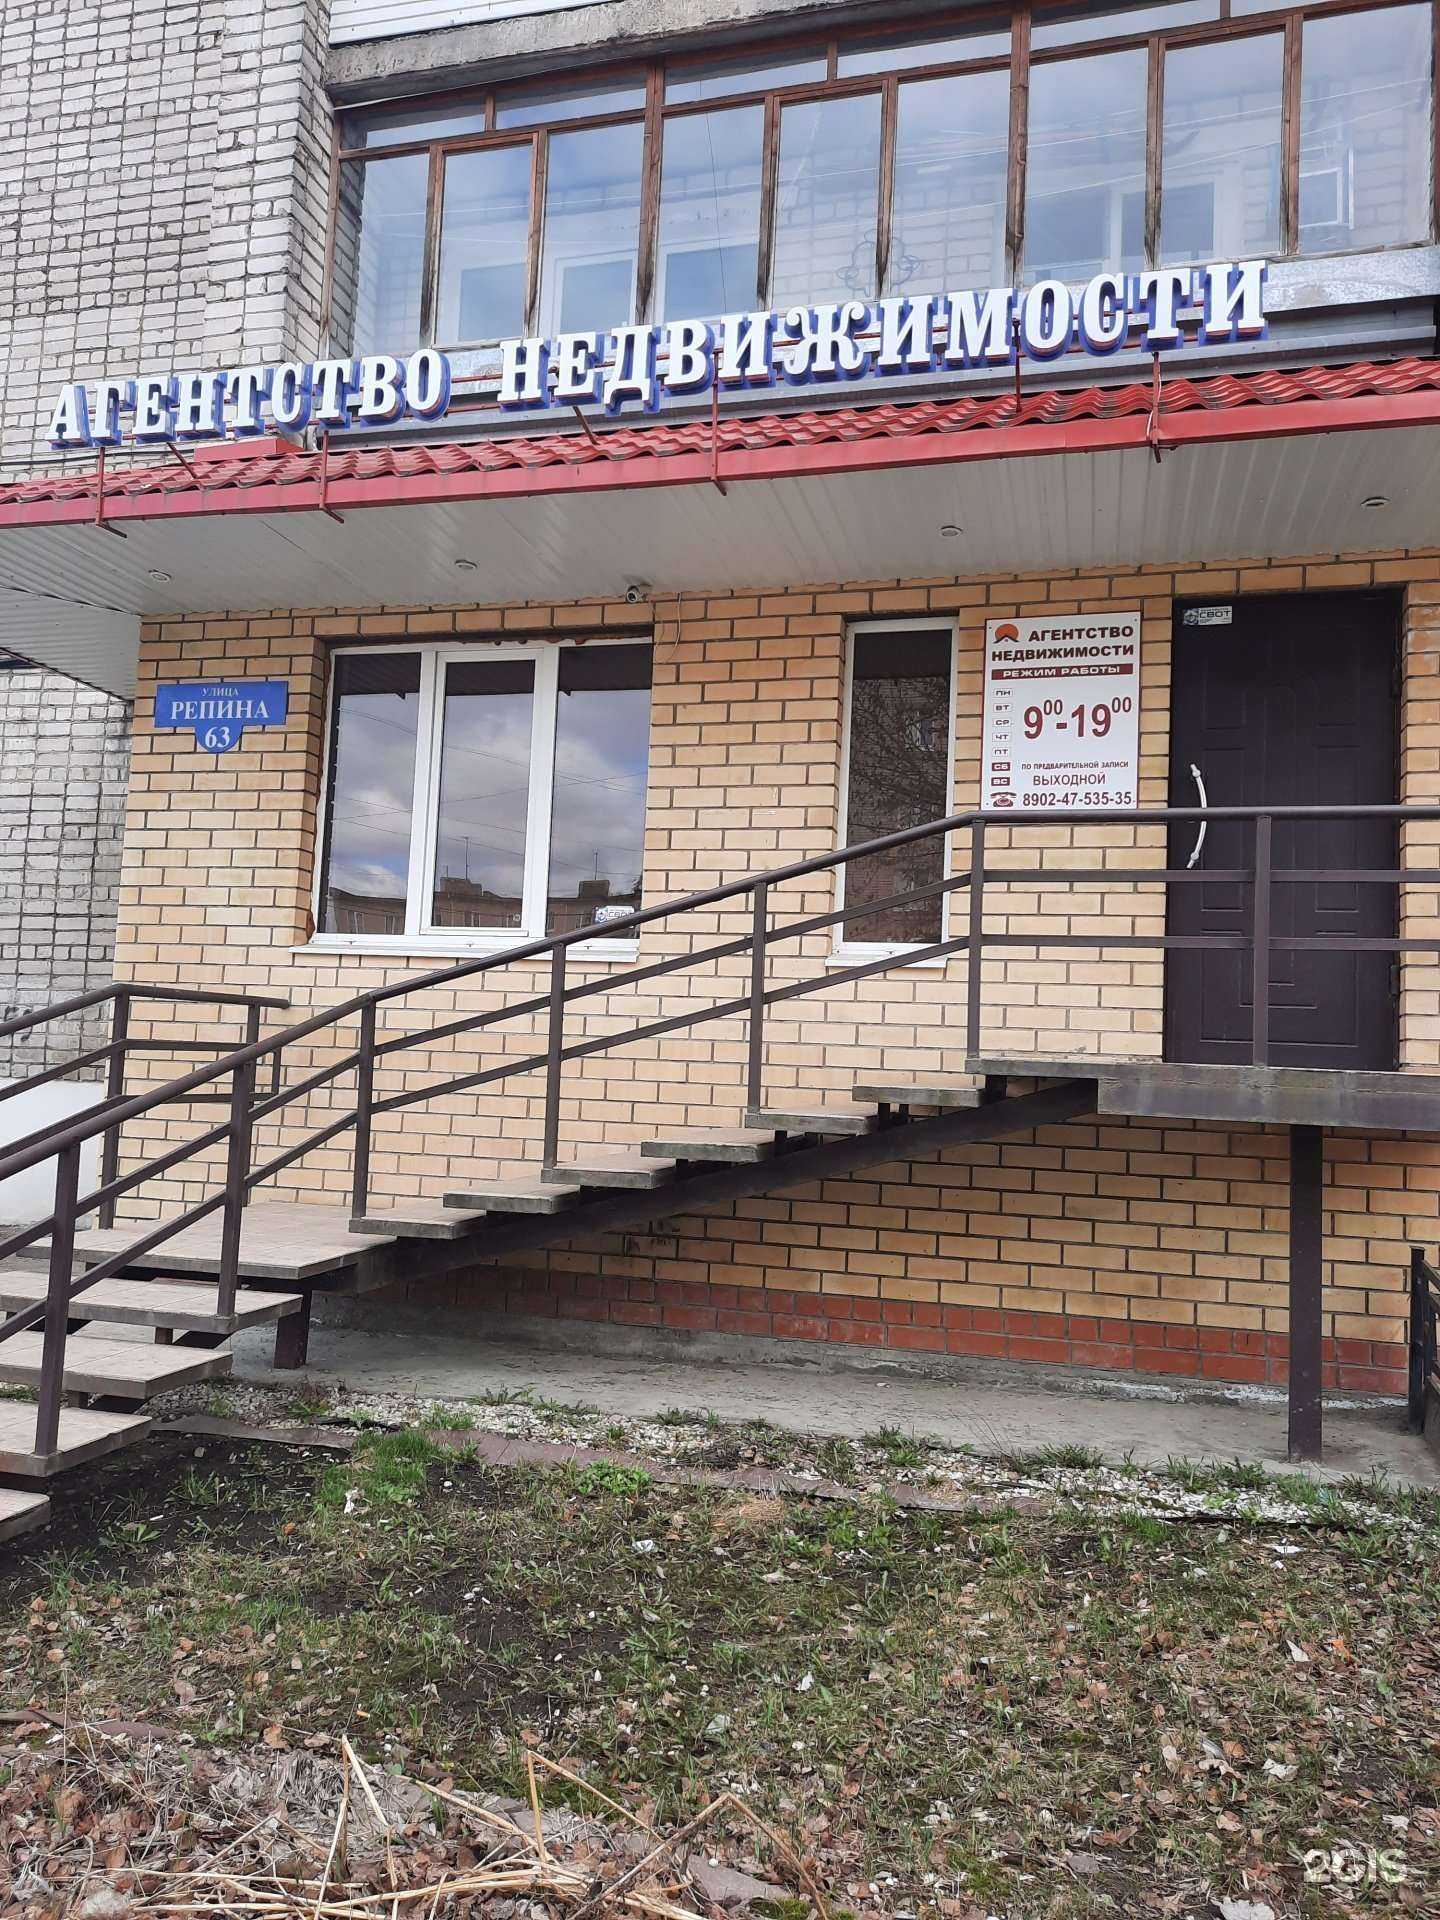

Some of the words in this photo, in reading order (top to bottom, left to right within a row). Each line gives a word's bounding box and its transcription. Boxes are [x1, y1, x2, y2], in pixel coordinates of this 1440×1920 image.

[45, 348, 450, 447] АГЕНТСТВО
[497, 259, 1269, 414] НЕДВИЖИМОСТИ
[1028, 625, 1134, 642] АГЕНТСТВО
[991, 644, 1134, 662] НЕДВИЖИМОСТИ
[1003, 667, 1056, 678] РЕЖИМ
[1061, 665, 1120, 676] РАБОТЫ
[200, 687, 239, 698] УЛИЦА
[169, 699, 270, 720] РЕПИНА
[204, 726, 231, 748] 63
[1033, 761, 1099, 769] ПРЕДВАРИТЕЛЬНОЙ
[1033, 772, 1106, 786] ВЫХОДНОЙ
[1022, 791, 1132, 806] 8902-47-535-35
